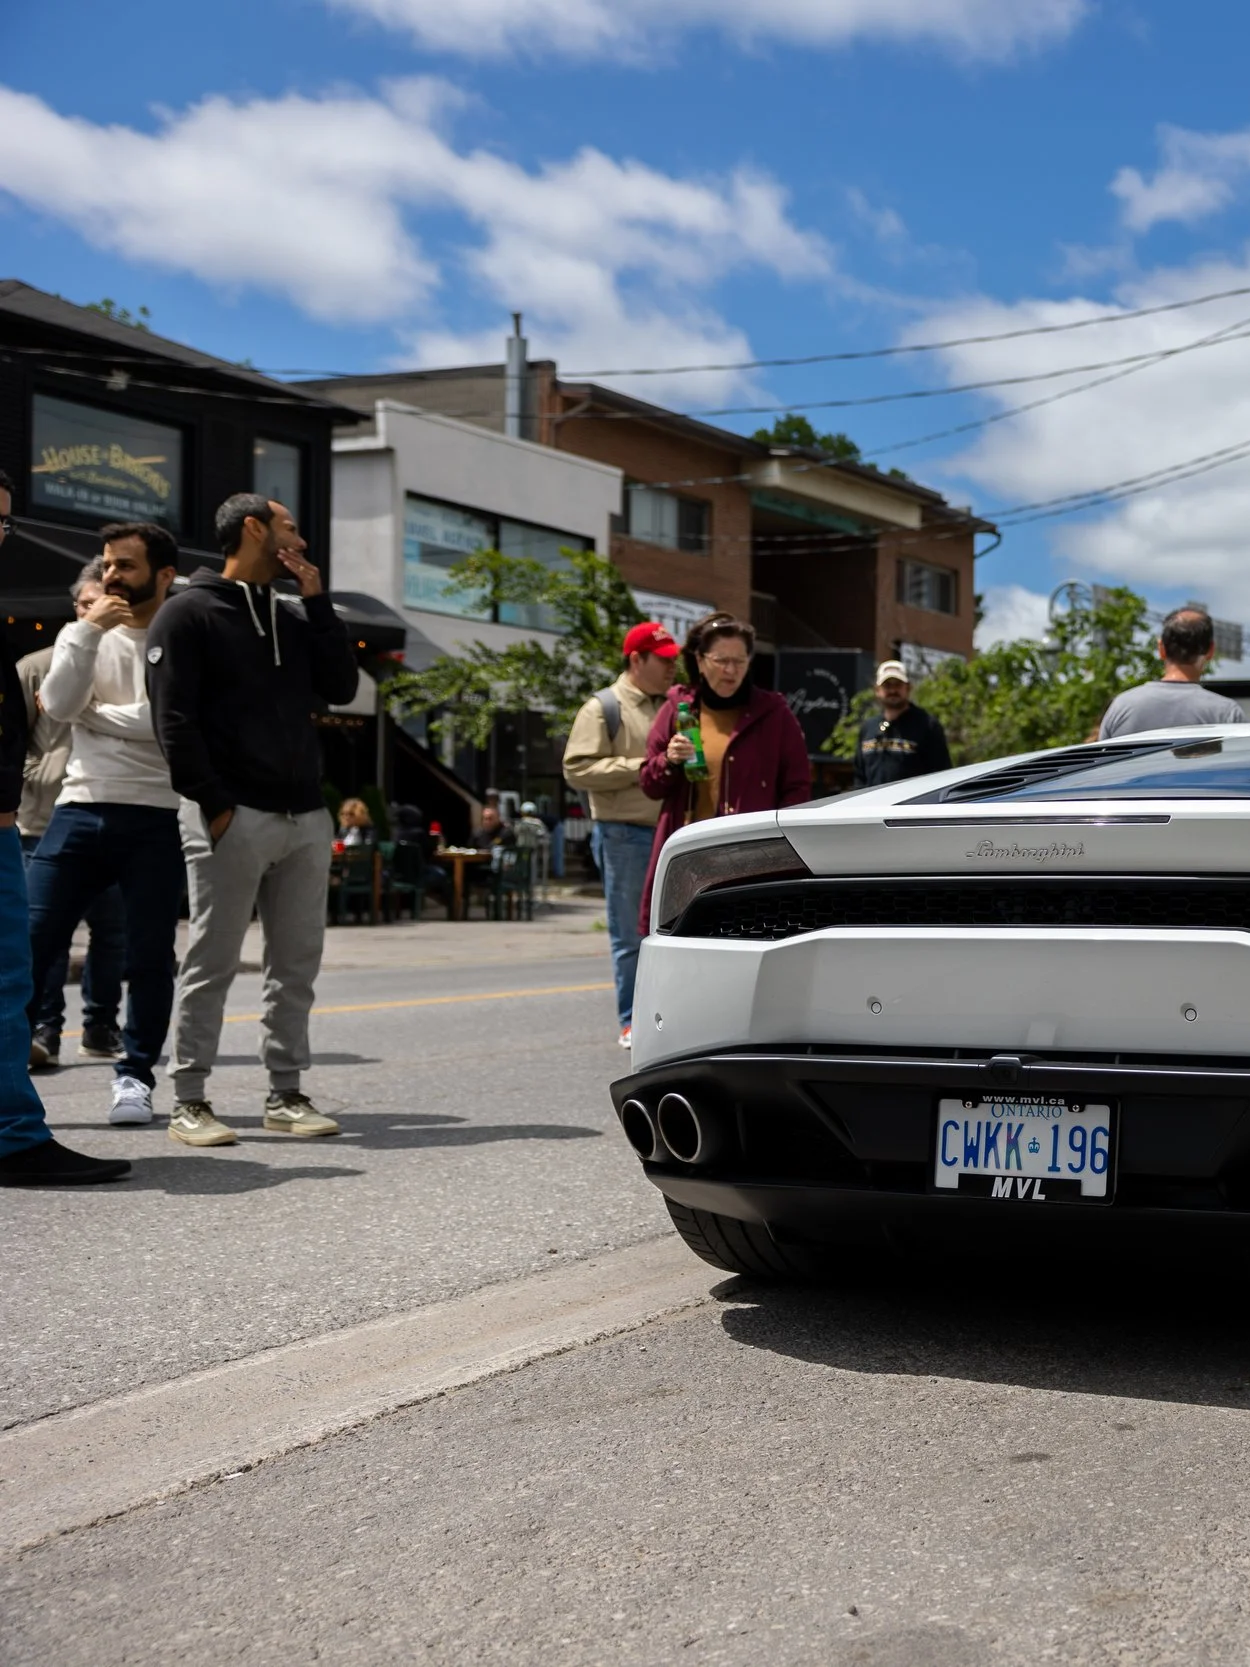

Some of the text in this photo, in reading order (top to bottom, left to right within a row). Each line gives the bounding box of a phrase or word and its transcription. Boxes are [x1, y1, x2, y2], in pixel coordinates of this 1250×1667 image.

[966, 839, 1085, 864] Lamborghini
[982, 1095, 1066, 1105] www.mvl.ca
[991, 1103, 1063, 1121] ONTARIO
[941, 1120, 1110, 1175] CWKK 196
[991, 1176, 1046, 1201] MVL
